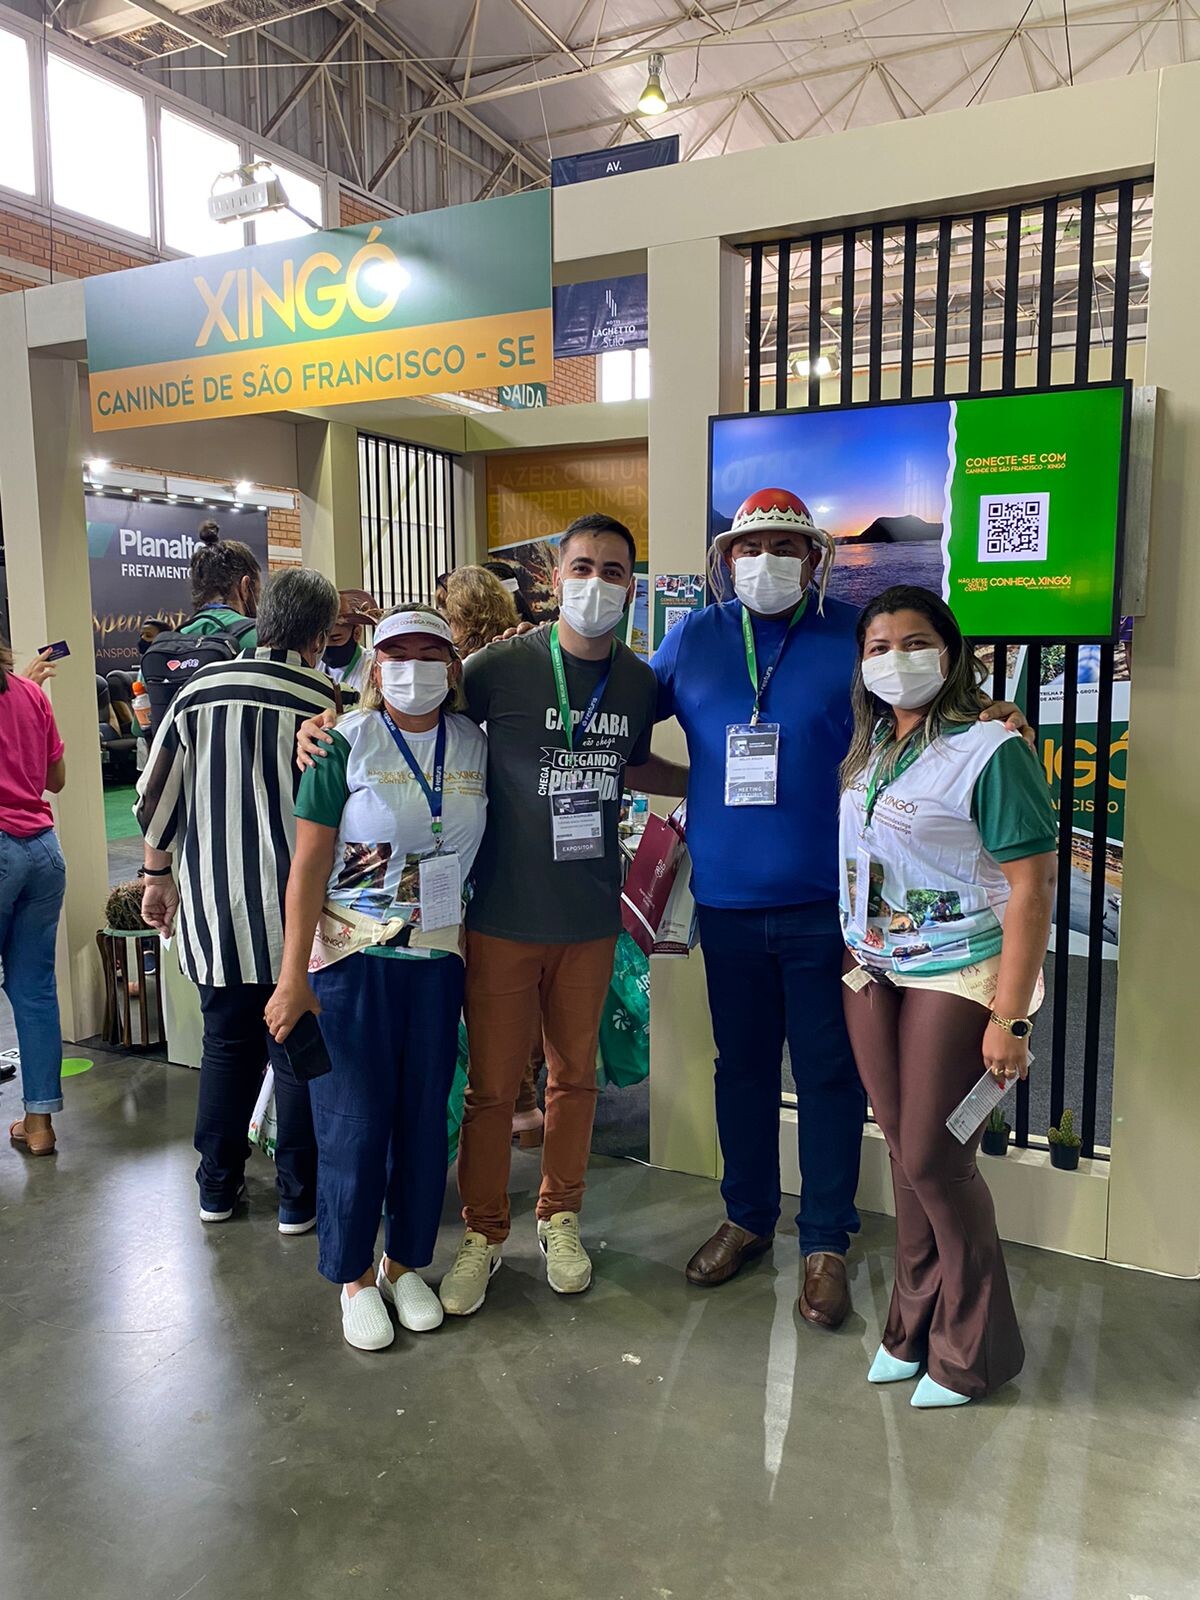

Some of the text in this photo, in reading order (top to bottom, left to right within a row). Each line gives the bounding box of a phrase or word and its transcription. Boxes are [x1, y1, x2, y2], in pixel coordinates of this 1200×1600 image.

[606, 160, 622, 173] AV.
[193, 225, 401, 347] XINGÓ
[592, 324, 636, 338] LAGHETTO
[603, 335, 625, 348] Stilo
[97, 374, 195, 416] CANINDÉ
[203, 374, 233, 403] DE
[242, 363, 293, 399] SÃO
[302, 344, 465, 391] FRANCISCO
[497, 335, 536, 368] SE
[965, 452, 1067, 467] CONECTE-SE COM
[989, 574, 1072, 587] CONHEÇA XINGÓ!
[595, 736, 616, 748] chega
[558, 753, 618, 767] CHEGANDO
[537, 766, 550, 796] CHEGA
[562, 844, 594, 852] EXPOSITOR
